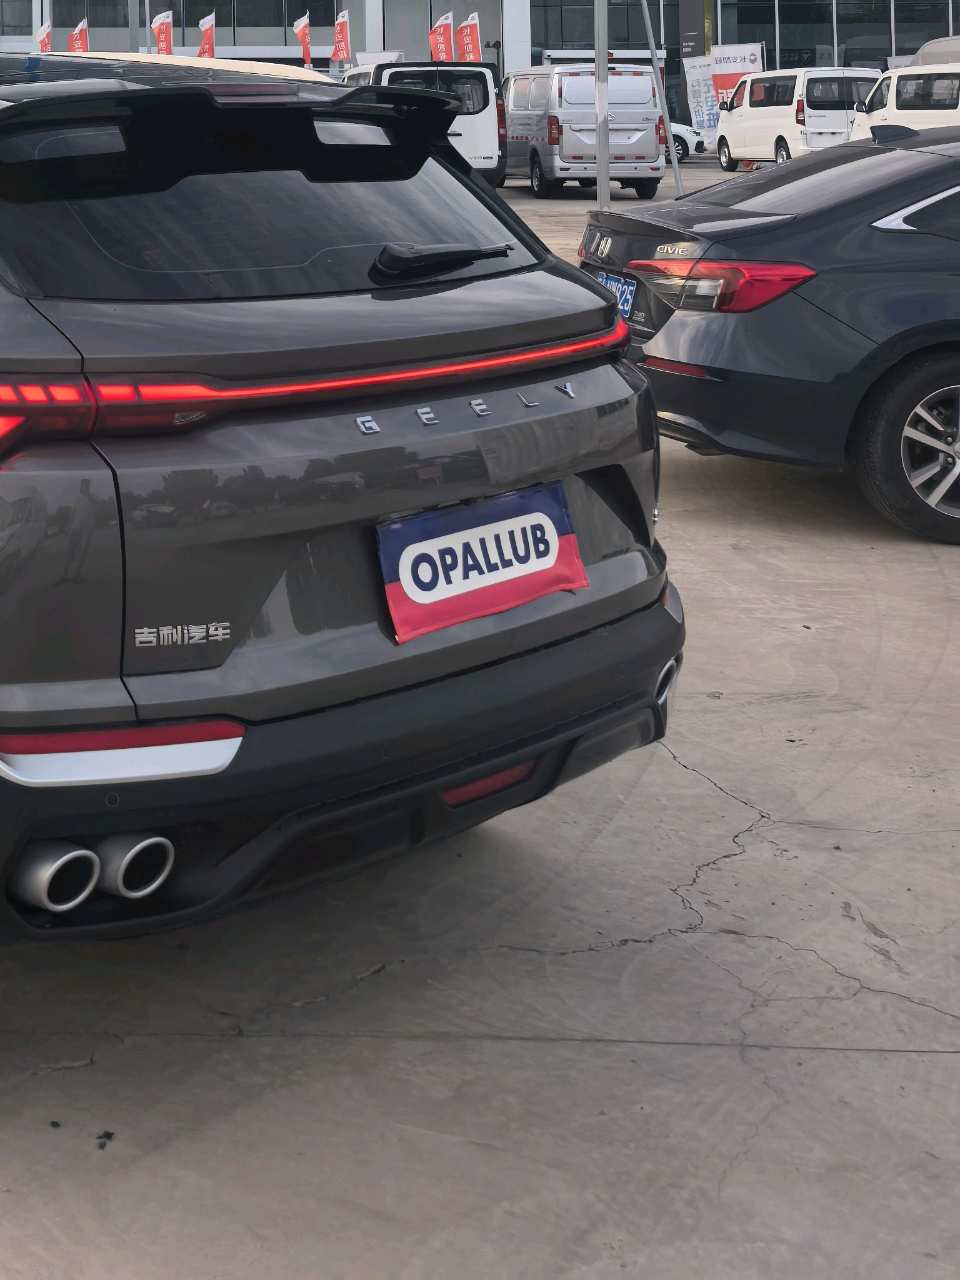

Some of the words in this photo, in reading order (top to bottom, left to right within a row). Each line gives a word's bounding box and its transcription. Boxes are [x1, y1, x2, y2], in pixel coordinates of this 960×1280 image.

[656, 245, 688, 256] CIVIC
[356, 382, 575, 435] GEELY
[410, 523, 550, 592] OPALLUB
[134, 622, 231, 647] 吉利汽车
